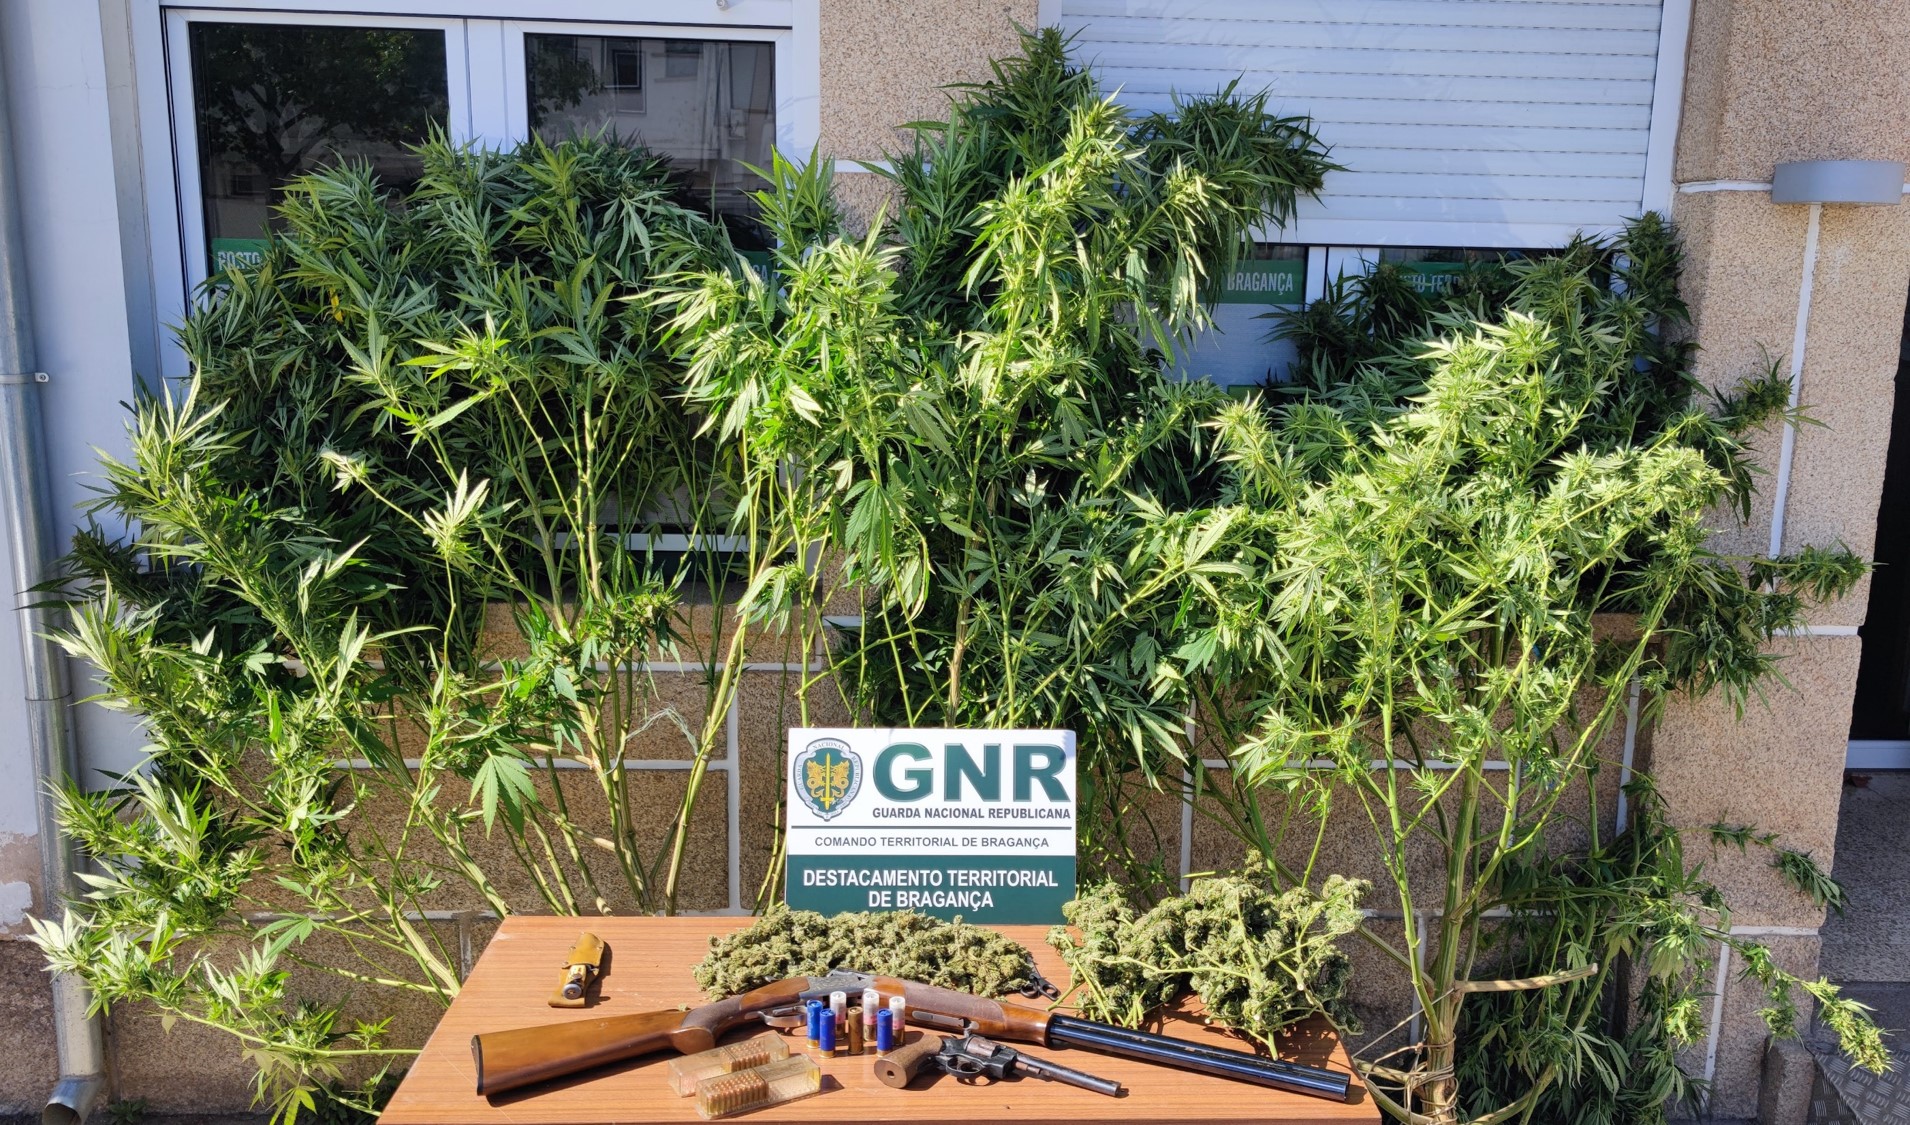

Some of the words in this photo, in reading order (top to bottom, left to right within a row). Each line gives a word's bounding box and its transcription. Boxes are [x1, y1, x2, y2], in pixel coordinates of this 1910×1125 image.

[1227, 272, 1293, 296] BRAGANÇA
[873, 742, 1071, 803] GNR
[872, 807, 921, 819] GUARDA
[924, 807, 985, 819] NACIONAL
[988, 807, 1071, 820] REPUBLICANA
[815, 836, 877, 847] COMANDO
[880, 836, 959, 848] TERRITORIAL
[961, 837, 978, 847] DE
[981, 837, 1049, 850] BRAGANÇA
[803, 869, 943, 887] DESTACAMENTO
[947, 870, 1058, 888] TERRITORIAL
[868, 890, 892, 907] DE
[896, 890, 994, 912] BRAGANÇA
